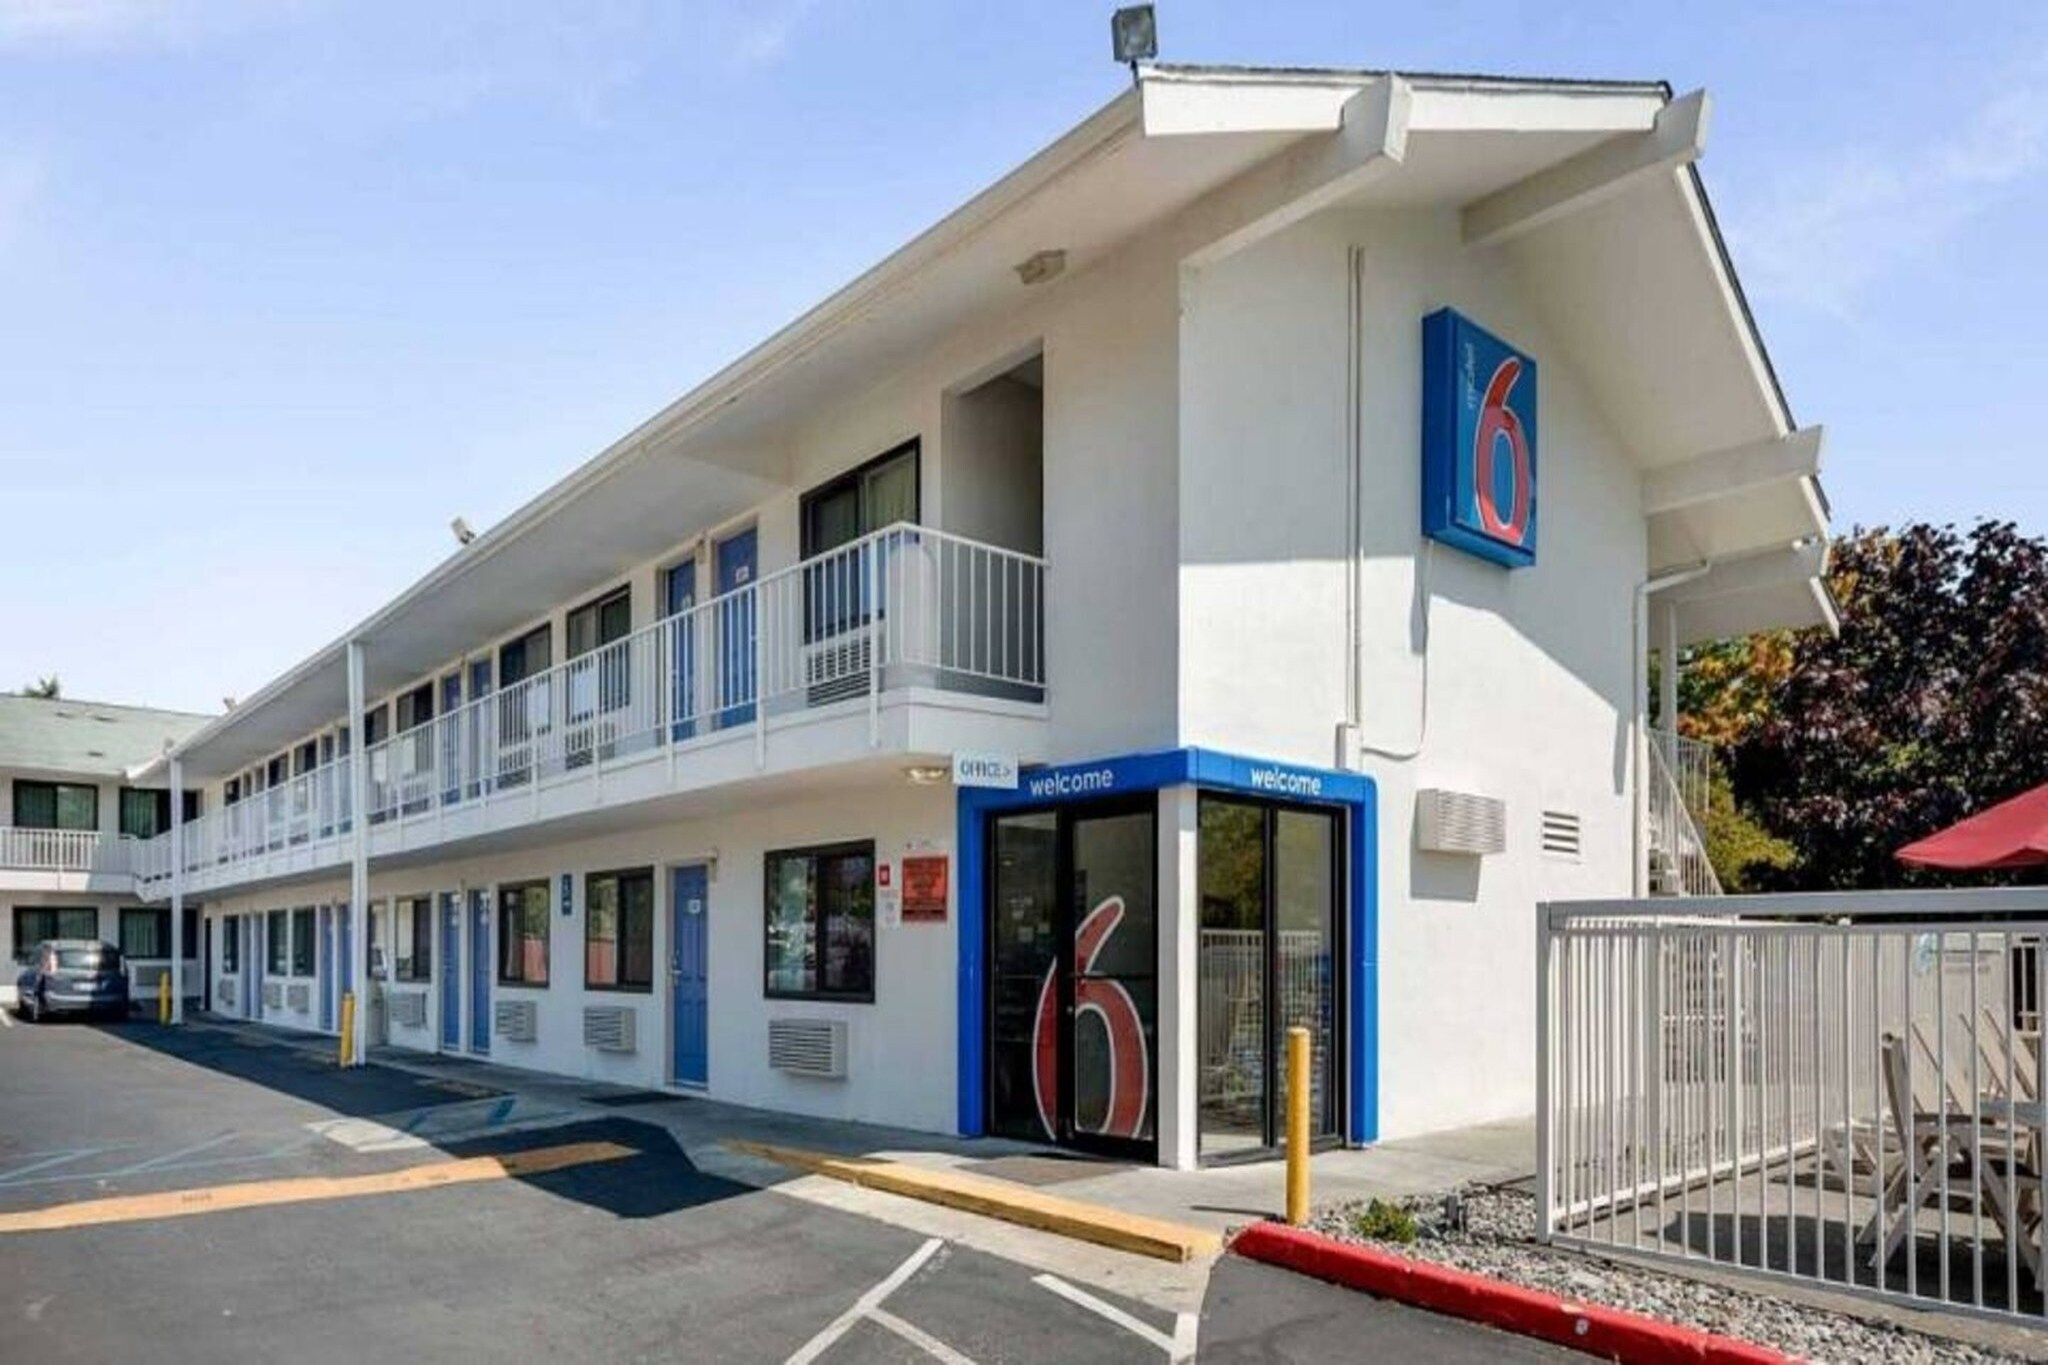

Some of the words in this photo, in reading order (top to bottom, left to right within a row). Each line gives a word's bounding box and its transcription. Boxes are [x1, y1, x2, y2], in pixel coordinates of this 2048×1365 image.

[1474, 357, 1530, 546] 6
[1029, 769, 1114, 796] welcome
[1250, 767, 1323, 796] welcome
[1033, 895, 1149, 1140] 6
